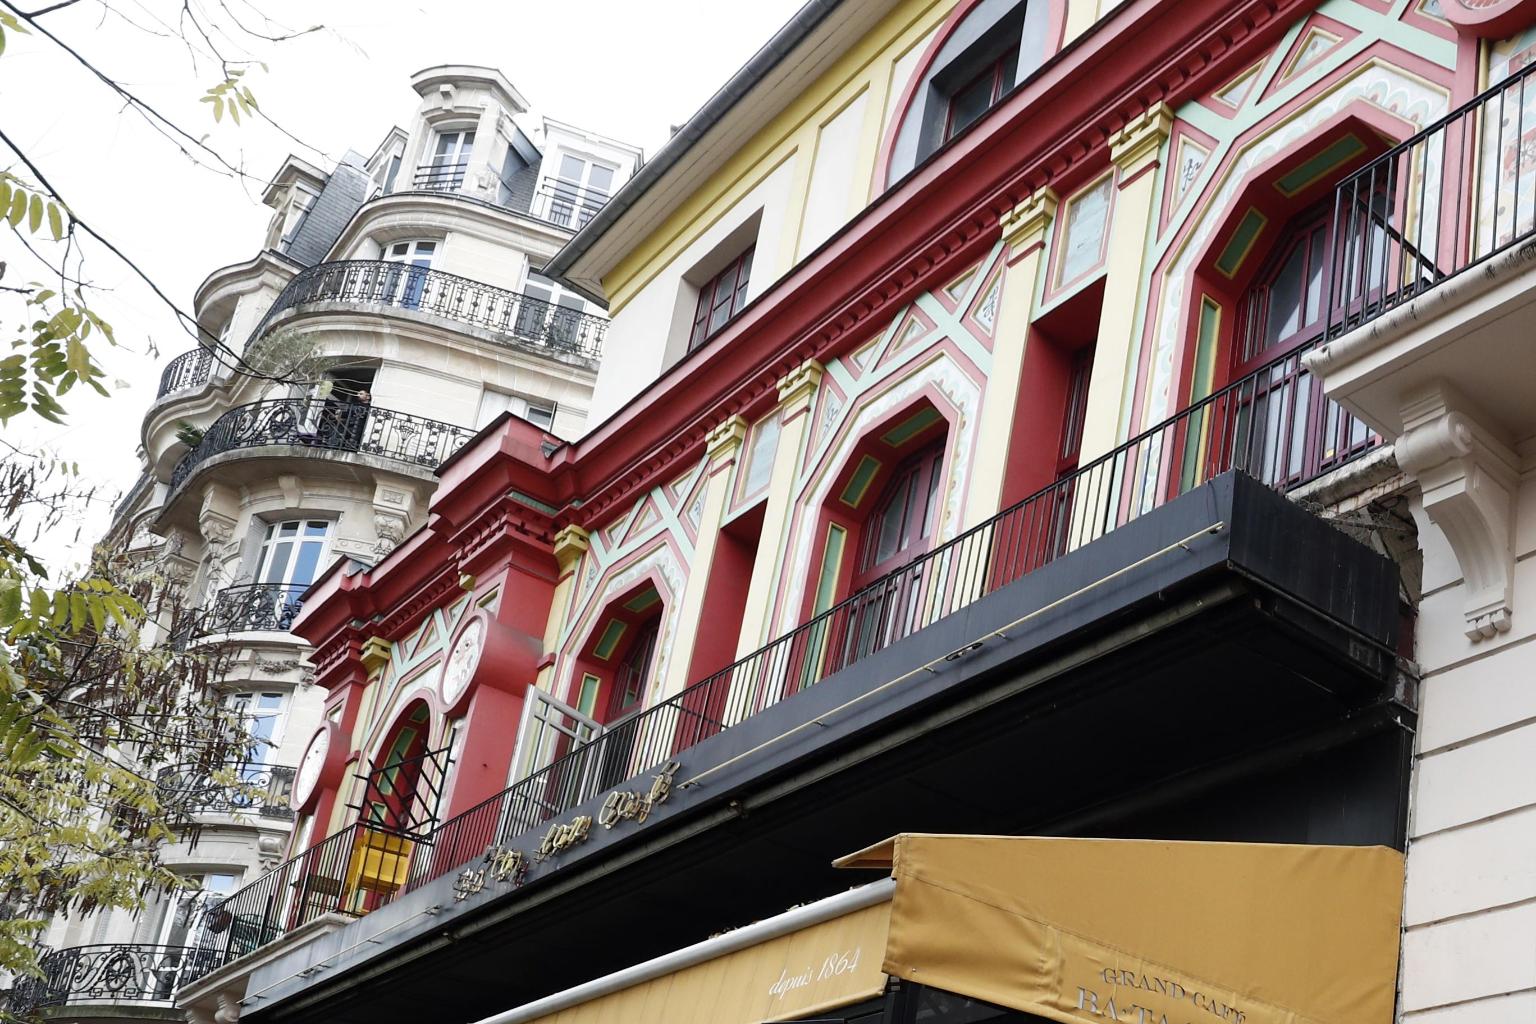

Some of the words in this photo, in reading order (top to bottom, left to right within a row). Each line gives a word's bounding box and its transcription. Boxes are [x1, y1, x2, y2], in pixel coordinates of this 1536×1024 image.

[768, 967, 814, 1000] depuis
[816, 946, 861, 982] 1864
[1102, 967, 1186, 1000] GRAND
